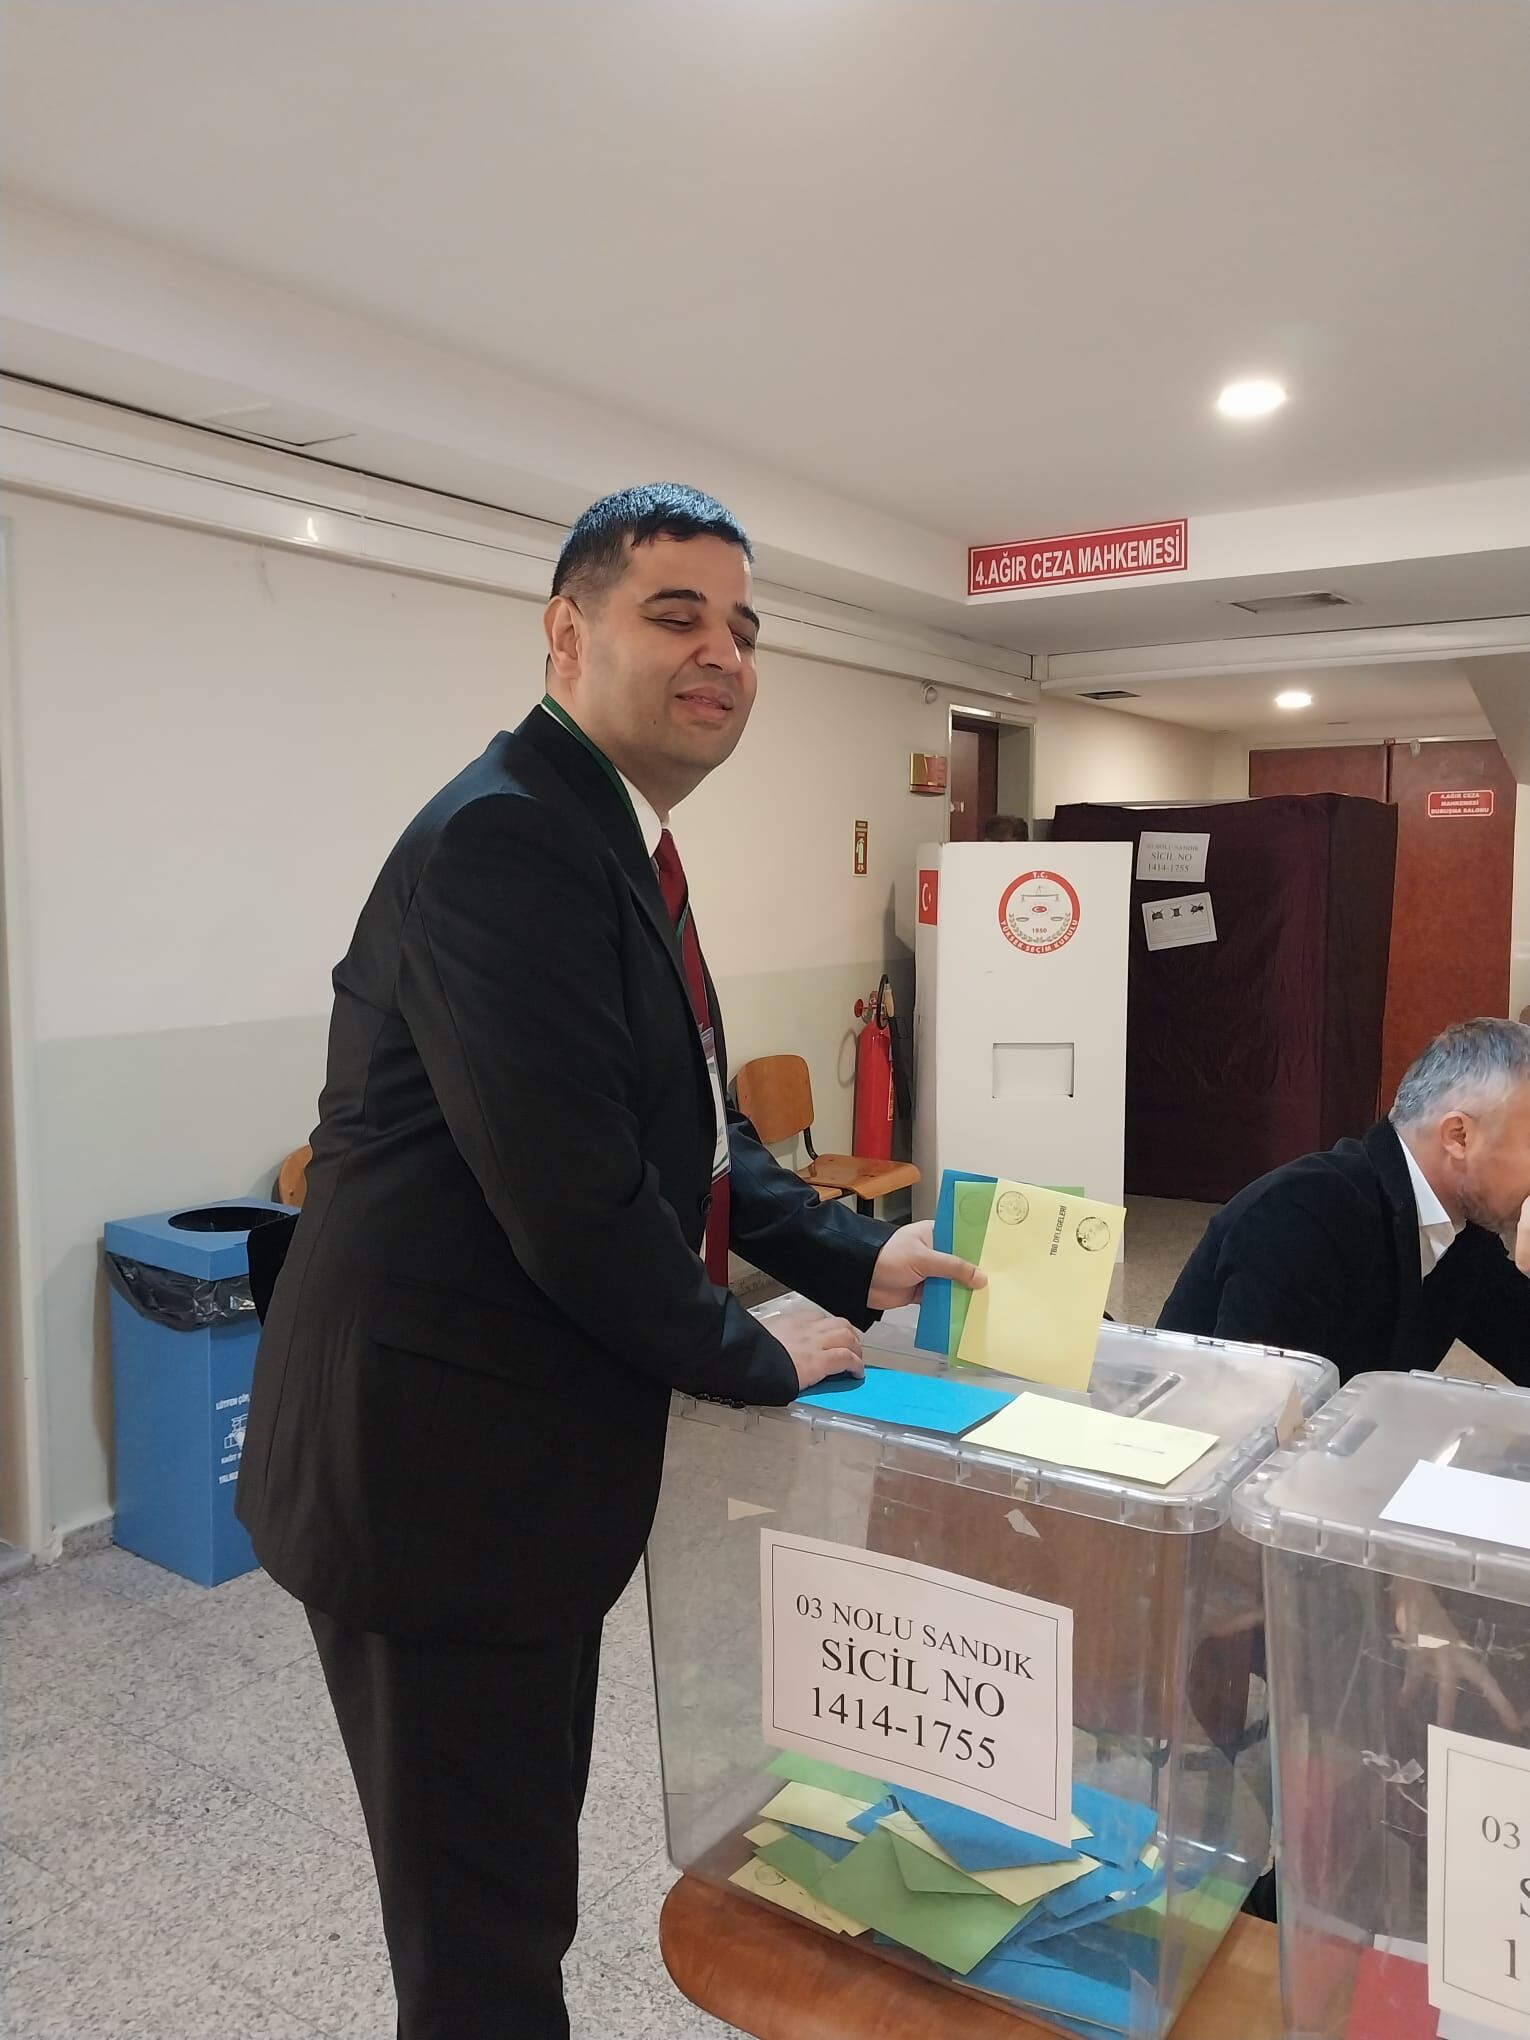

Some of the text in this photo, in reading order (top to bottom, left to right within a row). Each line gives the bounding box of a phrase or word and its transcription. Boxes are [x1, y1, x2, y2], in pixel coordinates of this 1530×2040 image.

[975, 529, 1180, 586] 4.AĞIR CEZA MAHKEMESİ
[796, 1594, 1035, 1681] 03 NOLU SANDIK
[822, 1637, 1006, 1718] SİCİL NO
[812, 1687, 996, 1769] 1414-1755
[1481, 1815, 1521, 1850] 03
